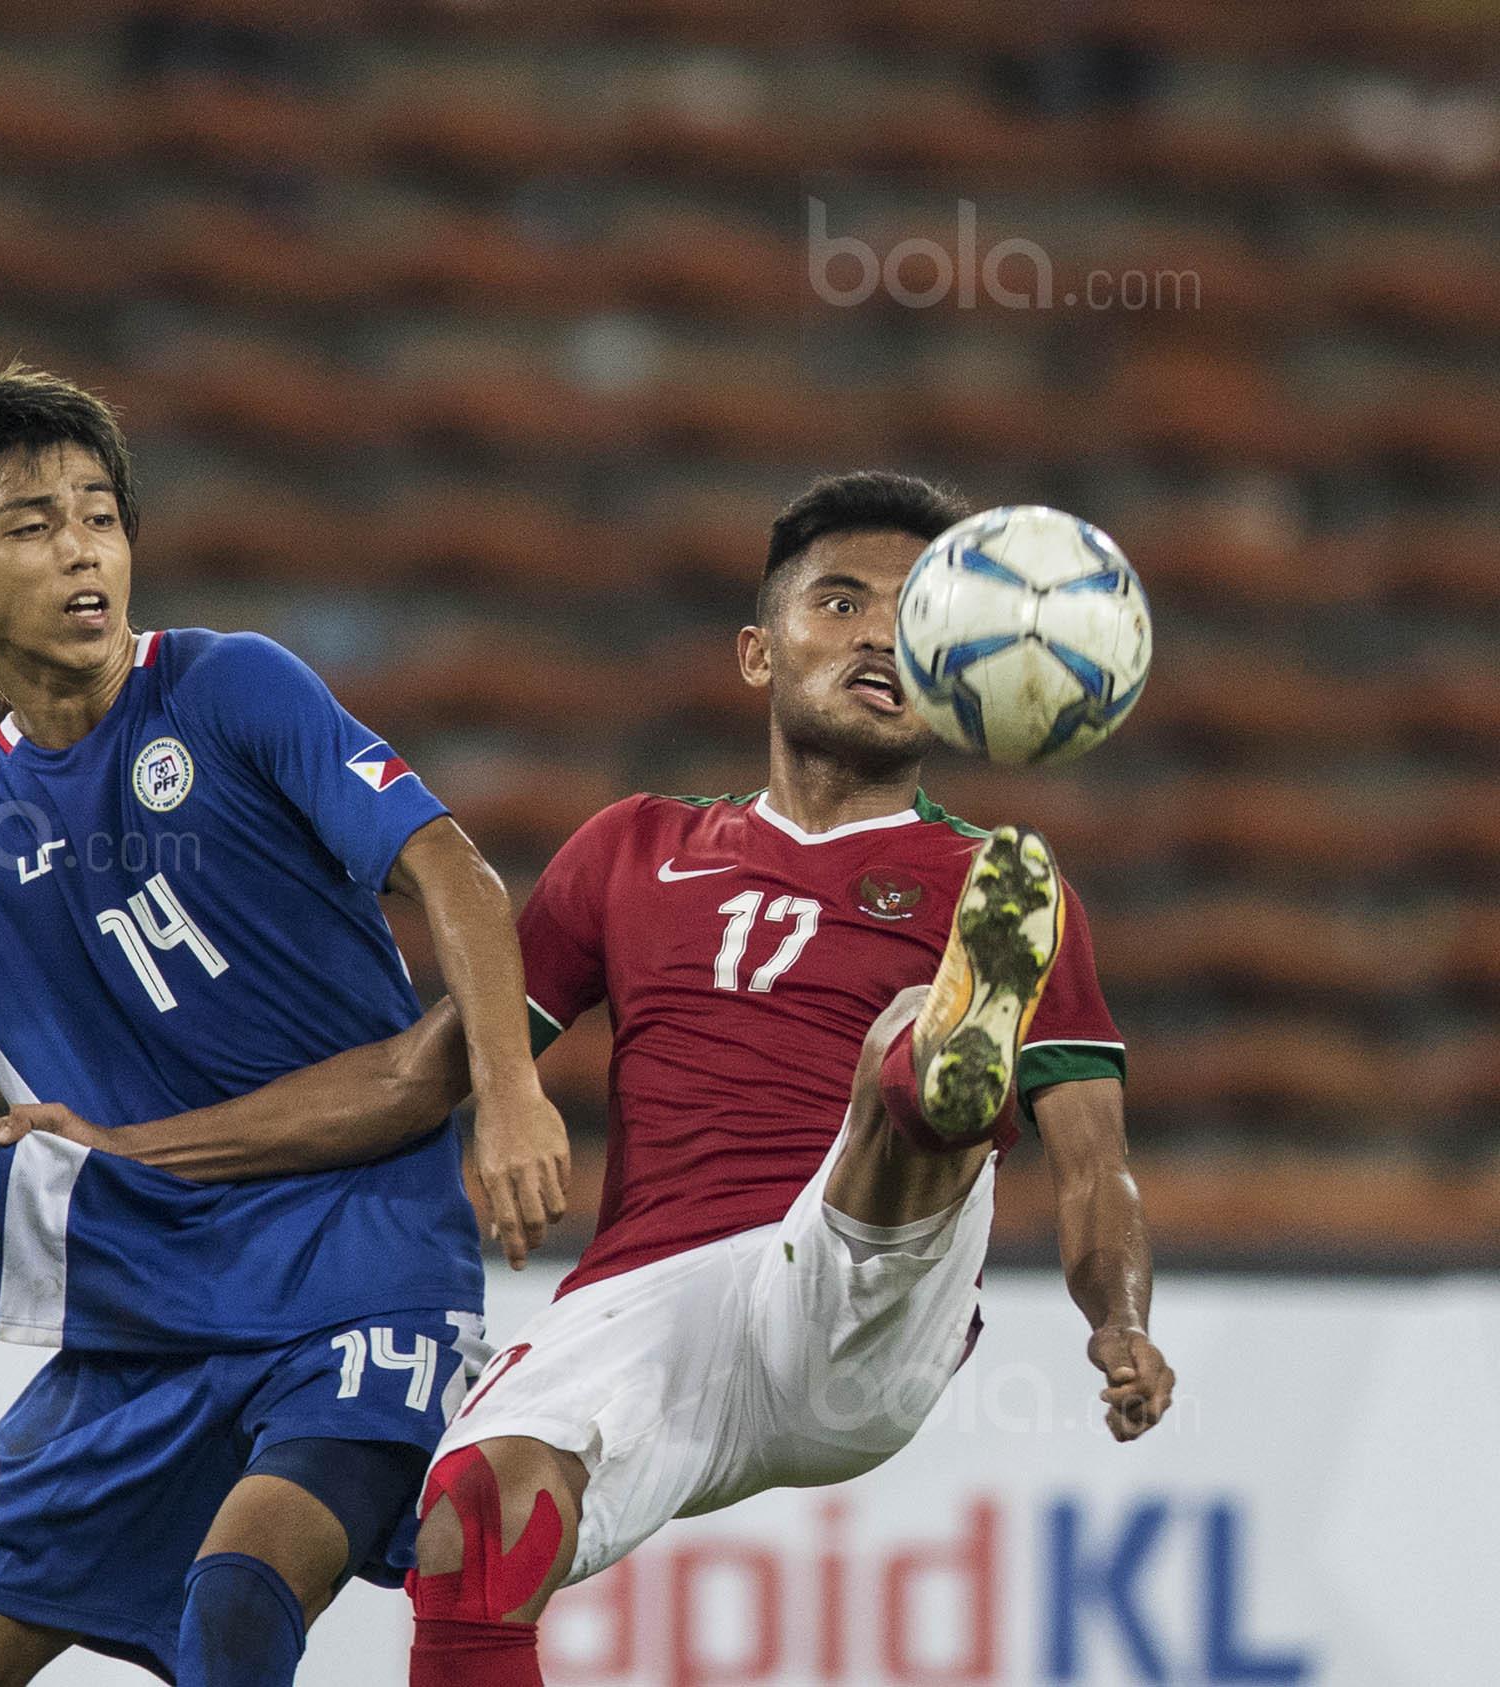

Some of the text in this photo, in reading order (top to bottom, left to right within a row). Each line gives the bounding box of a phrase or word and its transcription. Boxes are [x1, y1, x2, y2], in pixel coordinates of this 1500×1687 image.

[153, 772, 180, 796] PFF
[96, 872, 229, 1013] 14
[713, 890, 822, 992] 17
[331, 1327, 438, 1412] 14
[530, 1490, 1320, 1687] apidKL
